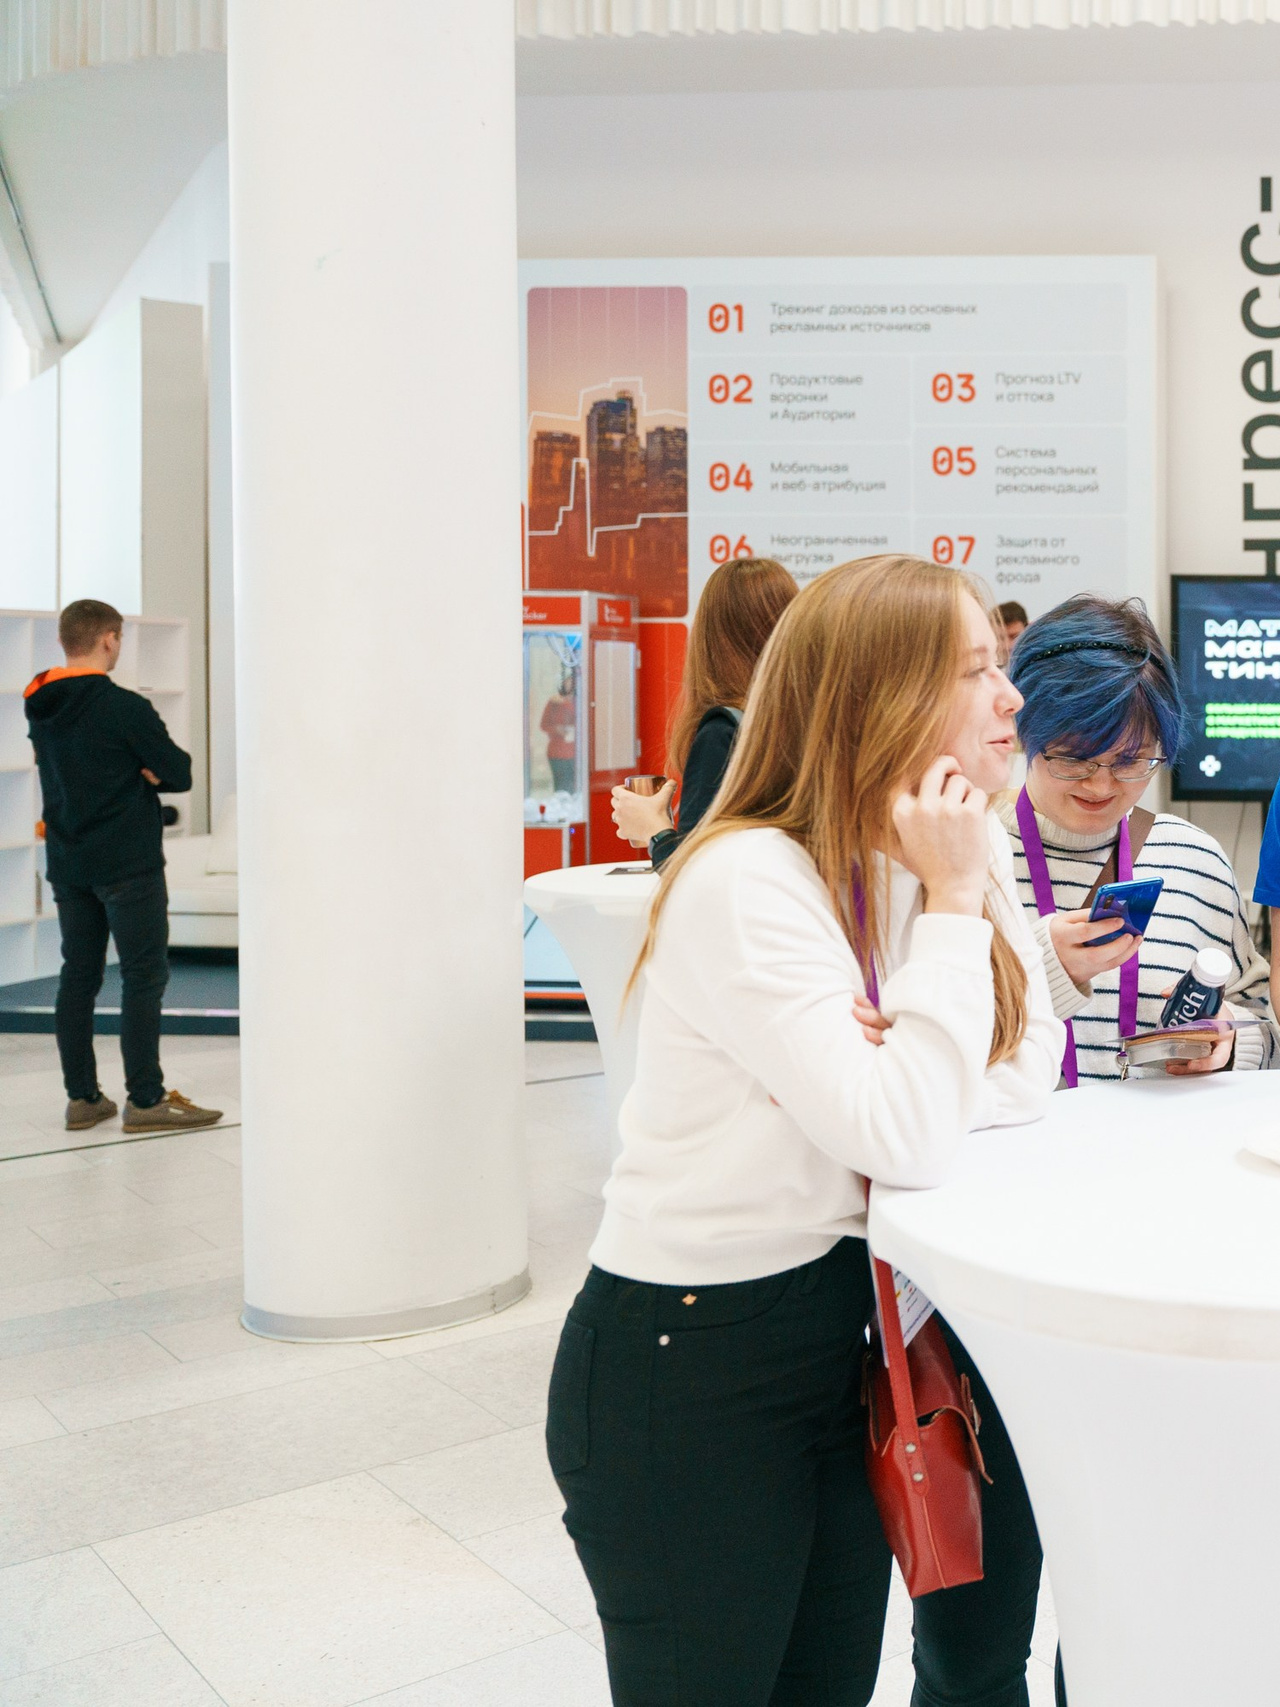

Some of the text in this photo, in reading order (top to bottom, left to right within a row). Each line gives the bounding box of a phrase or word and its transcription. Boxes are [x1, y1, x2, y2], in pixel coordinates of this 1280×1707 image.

[770, 303, 977, 316] Трекинг доходов из основных
[708, 303, 744, 333] 01
[770, 322, 932, 334] рекламных источников
[770, 373, 863, 387] Продуктовые
[995, 372, 1082, 387] Прогноз LTV
[708, 373, 753, 404] 02
[932, 372, 976, 403] 03
[770, 393, 828, 405] воронки
[995, 392, 1055, 402] и оттока
[770, 409, 857, 423] и Аудитории
[995, 447, 1057, 459] Система
[770, 462, 849, 474] Мобильная
[932, 446, 976, 476] 05
[708, 462, 753, 492] 04
[995, 466, 1097, 478] персональных
[770, 479, 887, 493] и веб-атрибуция
[995, 482, 1099, 496] рекомендаций
[770, 534, 888, 548] Неограниченная
[996, 536, 1066, 549] Защита от
[709, 534, 754, 564] 06
[932, 536, 976, 565] 07
[996, 555, 1080, 568] рекламного
[996, 572, 1041, 585] фрода
